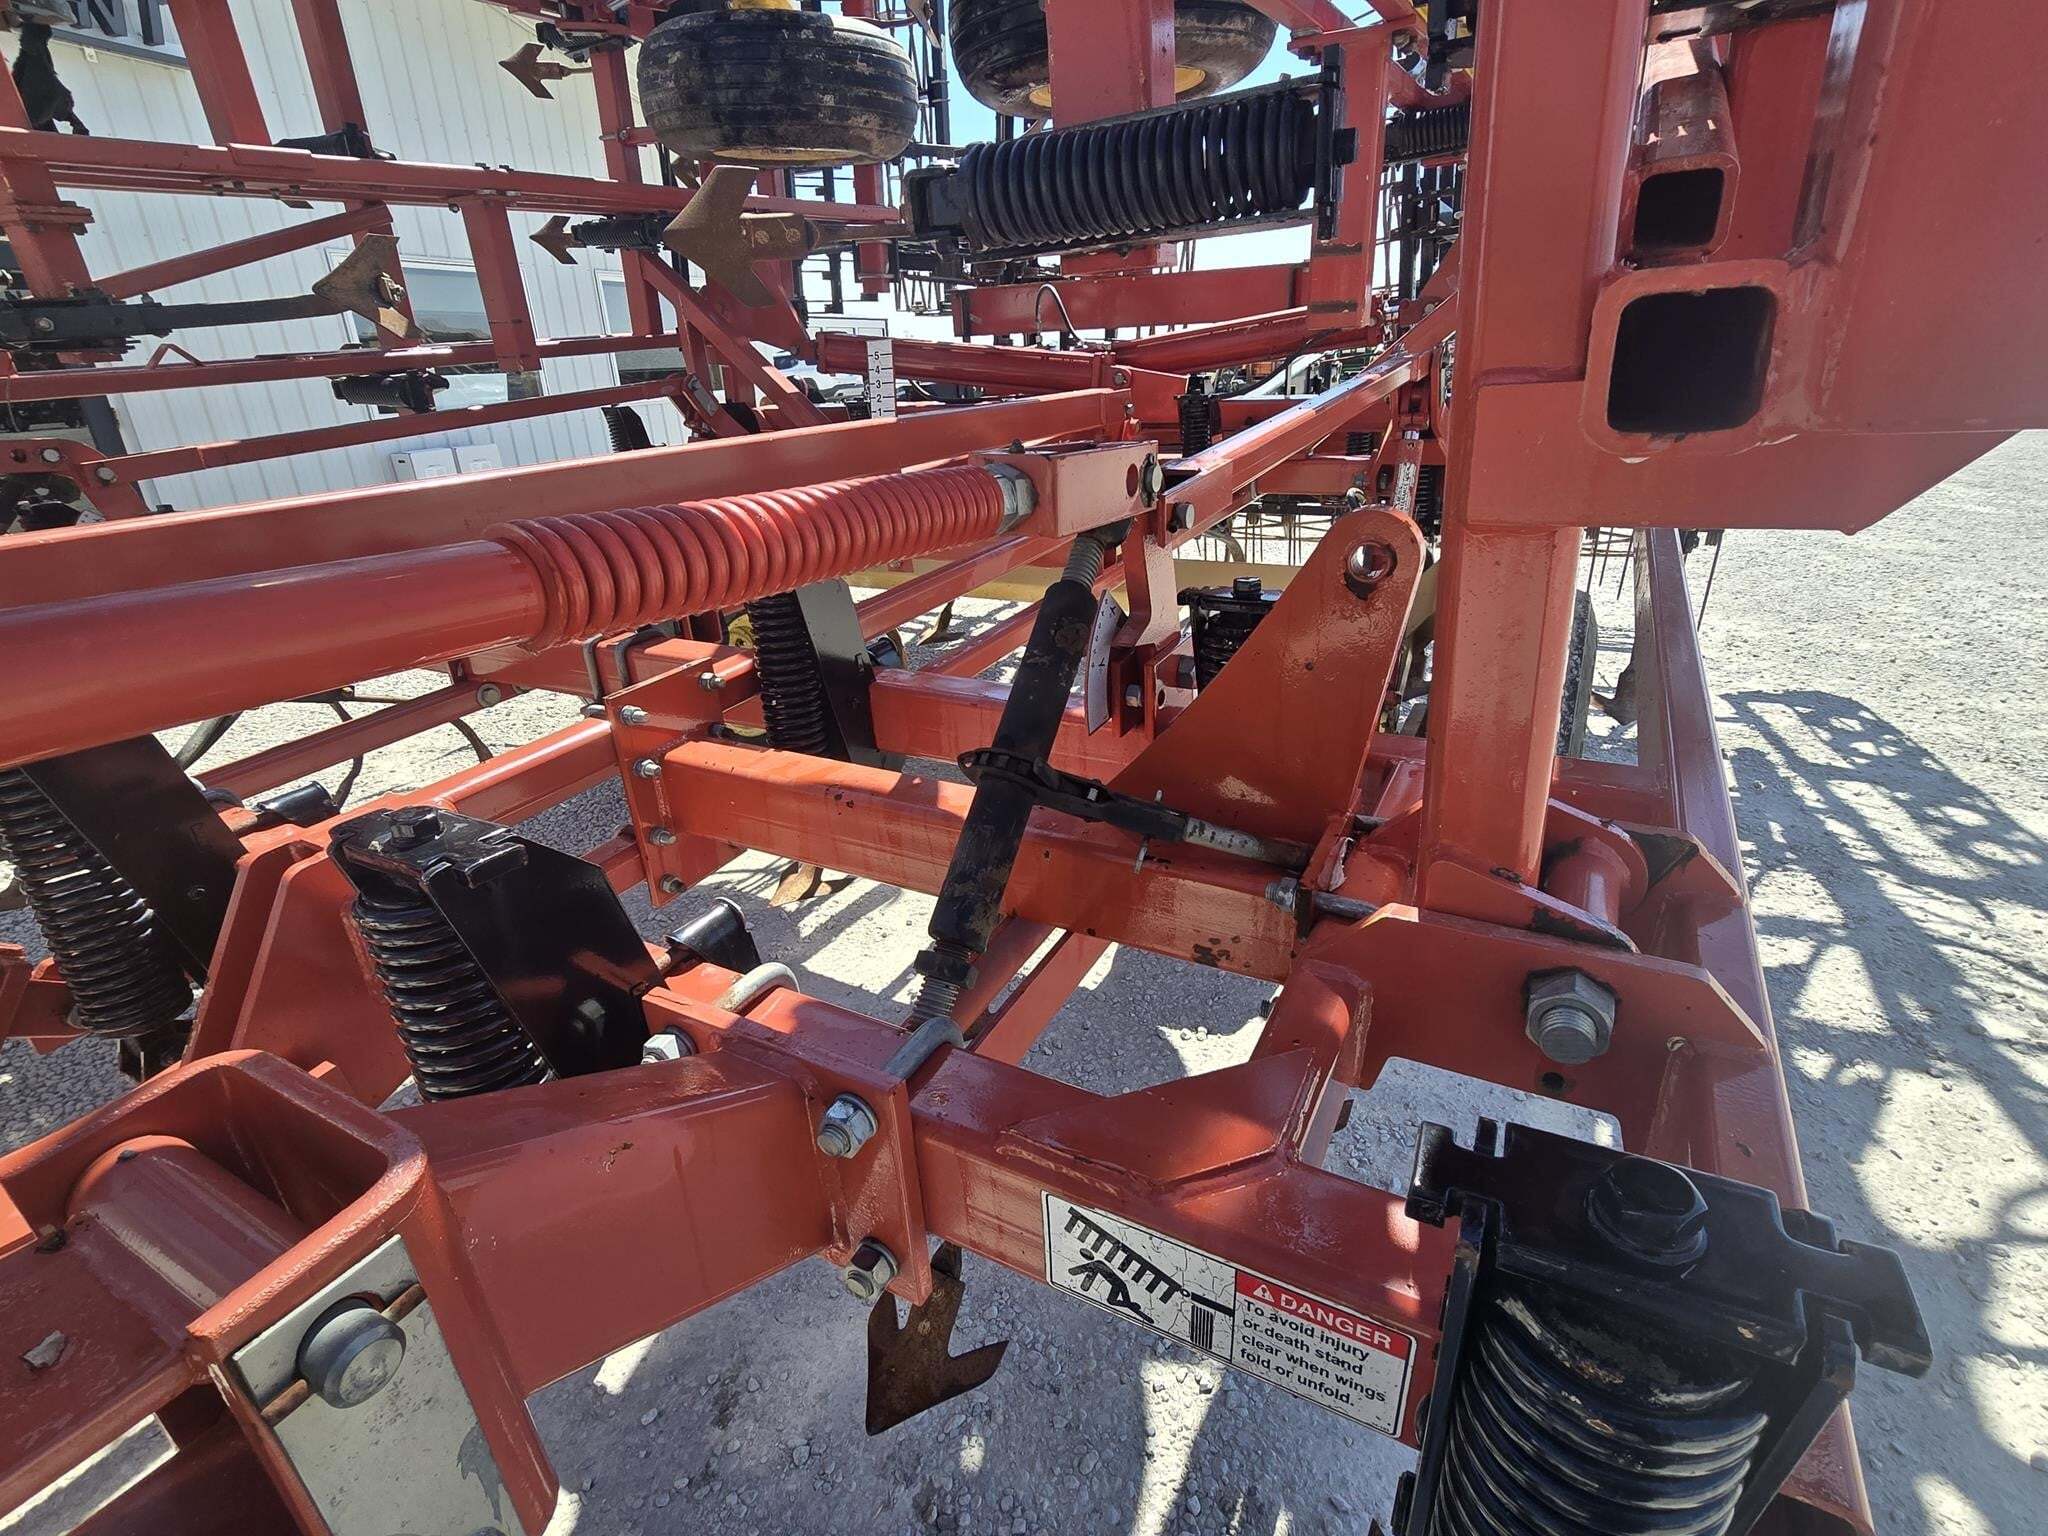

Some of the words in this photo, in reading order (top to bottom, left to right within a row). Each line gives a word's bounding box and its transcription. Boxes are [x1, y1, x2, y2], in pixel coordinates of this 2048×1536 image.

[876, 379, 882, 389] 3
[876, 393, 882, 403] 2
[1243, 1319, 1261, 1331] or
[1264, 1327, 1310, 1353] death
[1315, 1348, 1363, 1376] stand
[1244, 1298, 1265, 1317] To
[1269, 1312, 1315, 1338] avoid
[1320, 1330, 1370, 1361] injury
[1280, 1293, 1392, 1350] DANGER
[1240, 1347, 1271, 1371] fold
[1274, 1366, 1294, 1378] or
[1297, 1374, 1355, 1407] unfold.
[1241, 1335, 1282, 1357] clear
[1285, 1352, 1330, 1379] when
[1334, 1373, 1386, 1402] wings
